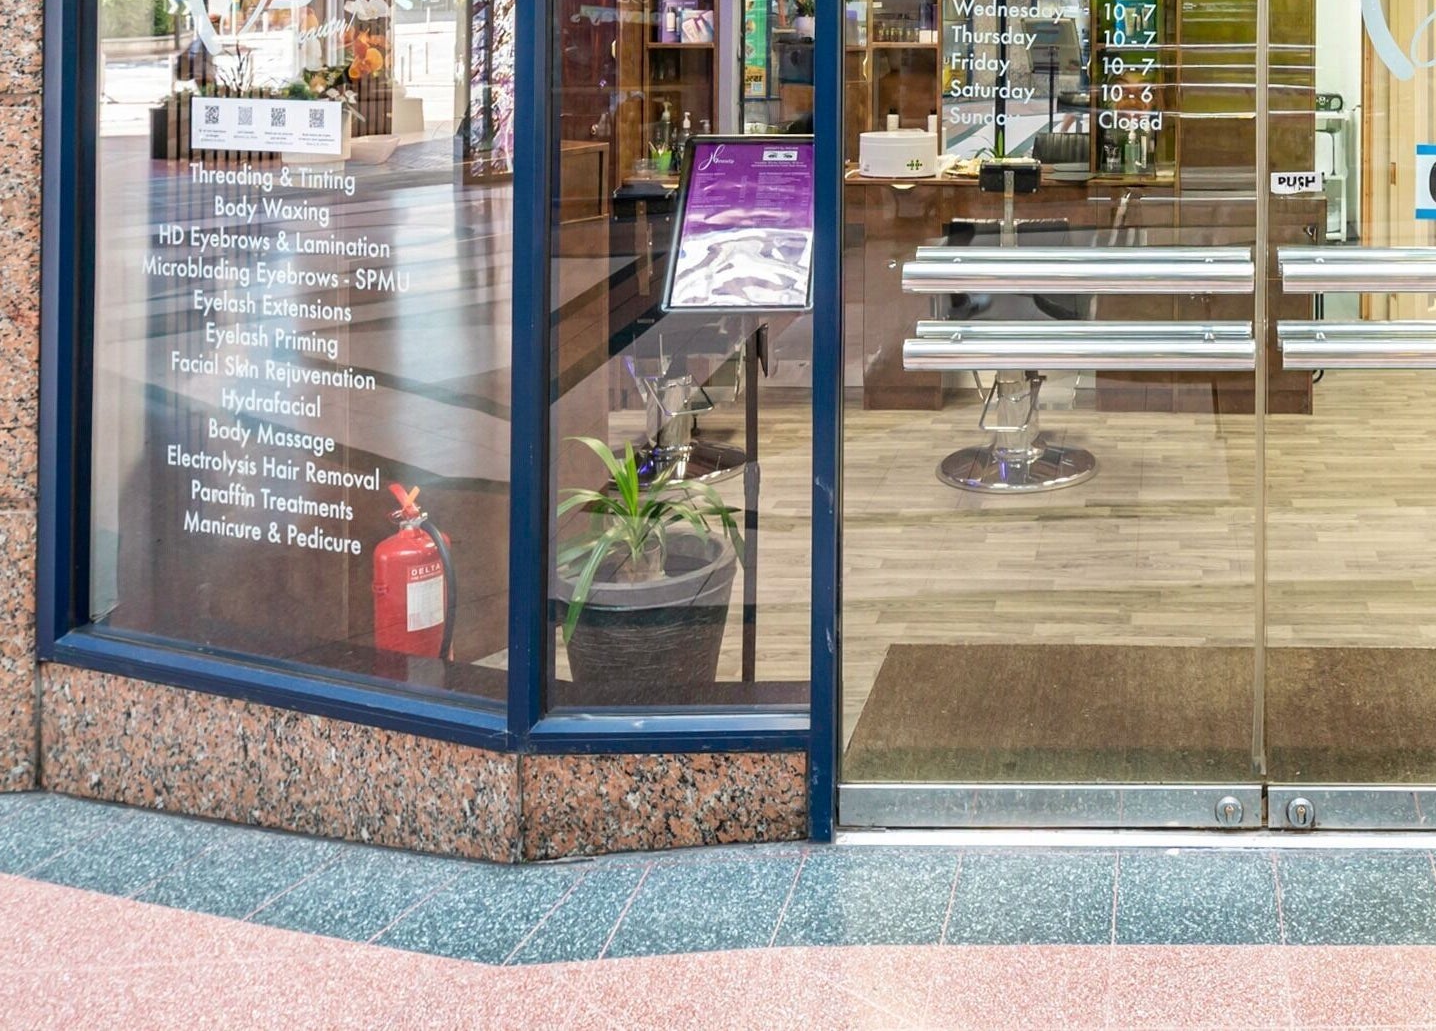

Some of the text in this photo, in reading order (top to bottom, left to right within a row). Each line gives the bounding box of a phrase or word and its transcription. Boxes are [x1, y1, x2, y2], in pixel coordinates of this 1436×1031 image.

[951, 25, 1037, 49] Thursday
[951, 53, 1010, 77] Friday
[950, 79, 1035, 105] Saturday
[950, 107, 1021, 126] Sunda
[1098, 110, 1163, 131] Closed
[190, 163, 356, 196] Threading & Tinting
[1278, 176, 1315, 189] PUSH
[215, 195, 330, 227] Body Waxing
[159, 225, 390, 259] HD Eyebrows & Lamination
[142, 256, 251, 287] Microblading
[257, 262, 338, 289] Eyebrows
[355, 269, 410, 293] SPMU
[194, 289, 352, 322] Eyelash Extensions
[205, 322, 339, 360] Eyelash Priming
[171, 351, 376, 390] Facial Skin Rejuvenation
[222, 388, 321, 418] Hydrafacial
[208, 418, 335, 457] Body Massage
[167, 445, 380, 491] Electrolysis Hair Removal
[191, 479, 354, 520] Paraffin Treatments
[184, 510, 362, 555] Manicure & Pedicure
[411, 562, 440, 577] DELTA
